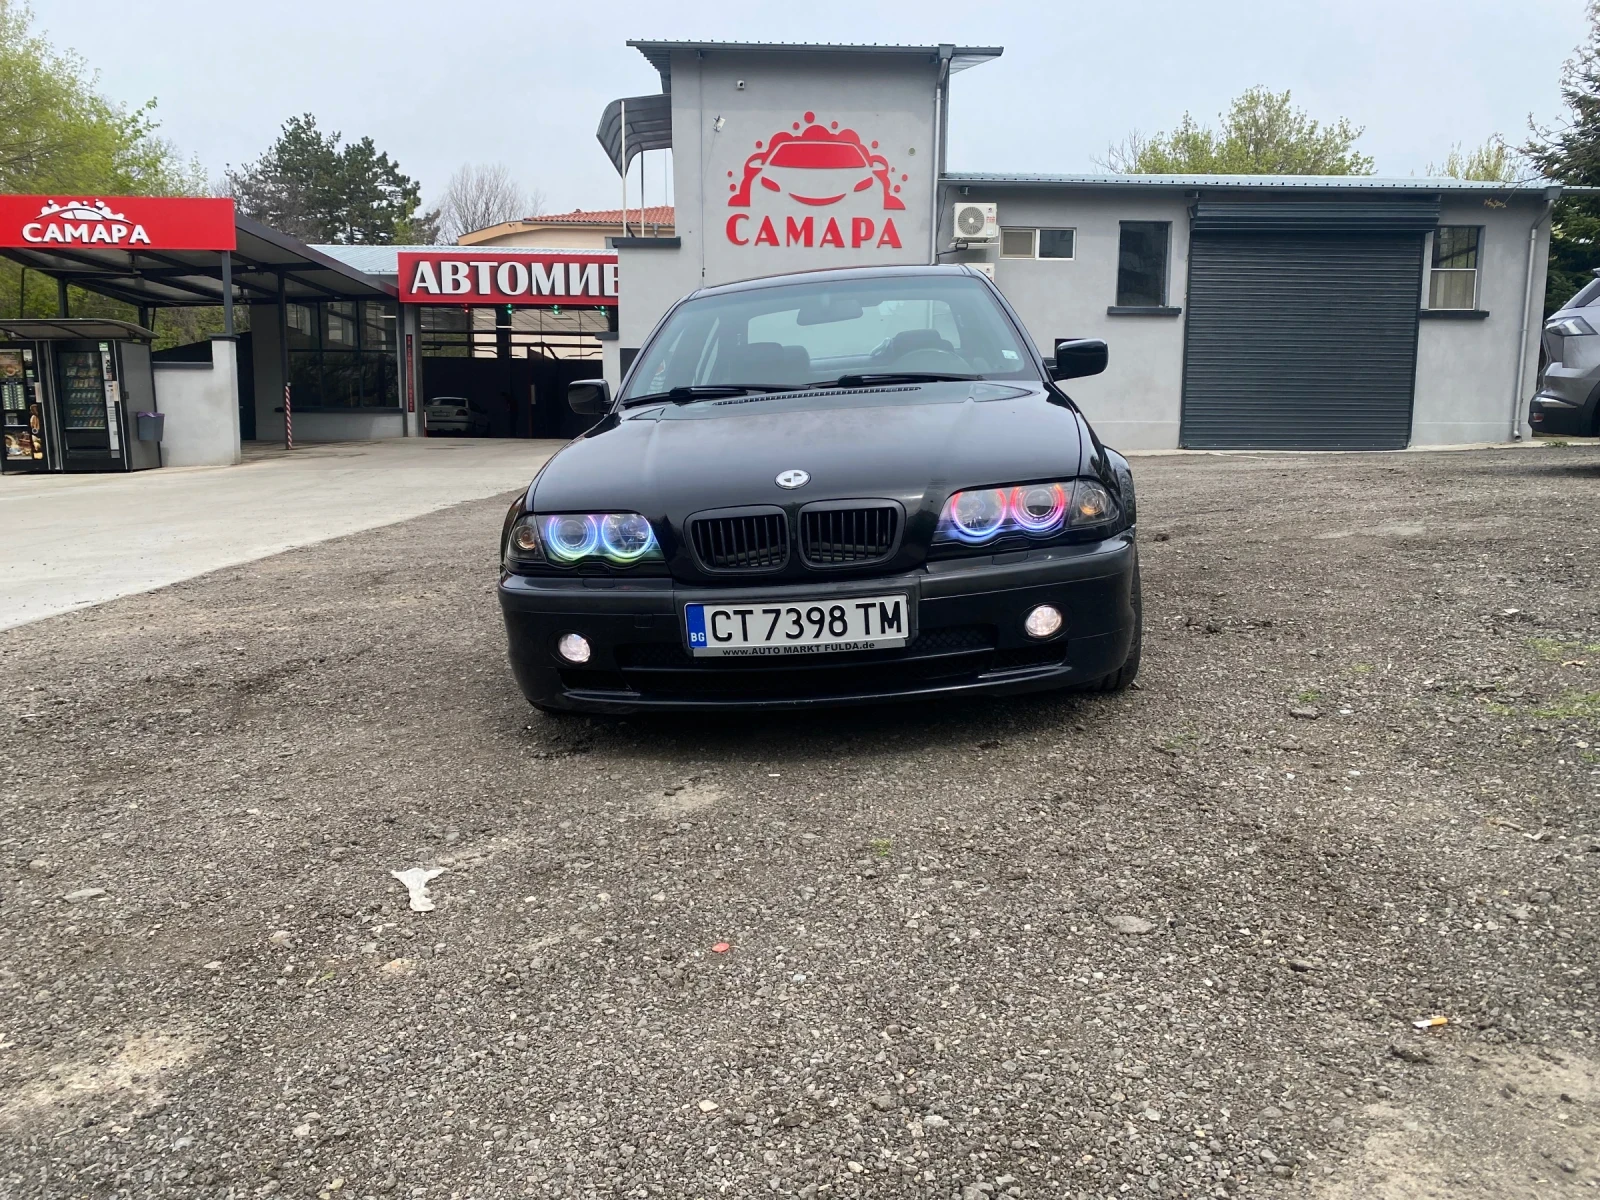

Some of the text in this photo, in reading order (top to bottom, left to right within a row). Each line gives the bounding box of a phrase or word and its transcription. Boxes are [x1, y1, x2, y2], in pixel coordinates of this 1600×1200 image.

[22, 222, 152, 246] САМАРА
[725, 213, 903, 249] САМАРА
[711, 600, 903, 642] CT 7398 TM
[691, 632, 705, 642] BG
[722, 640, 875, 656] www.AUTO MARKT FULDA.de
